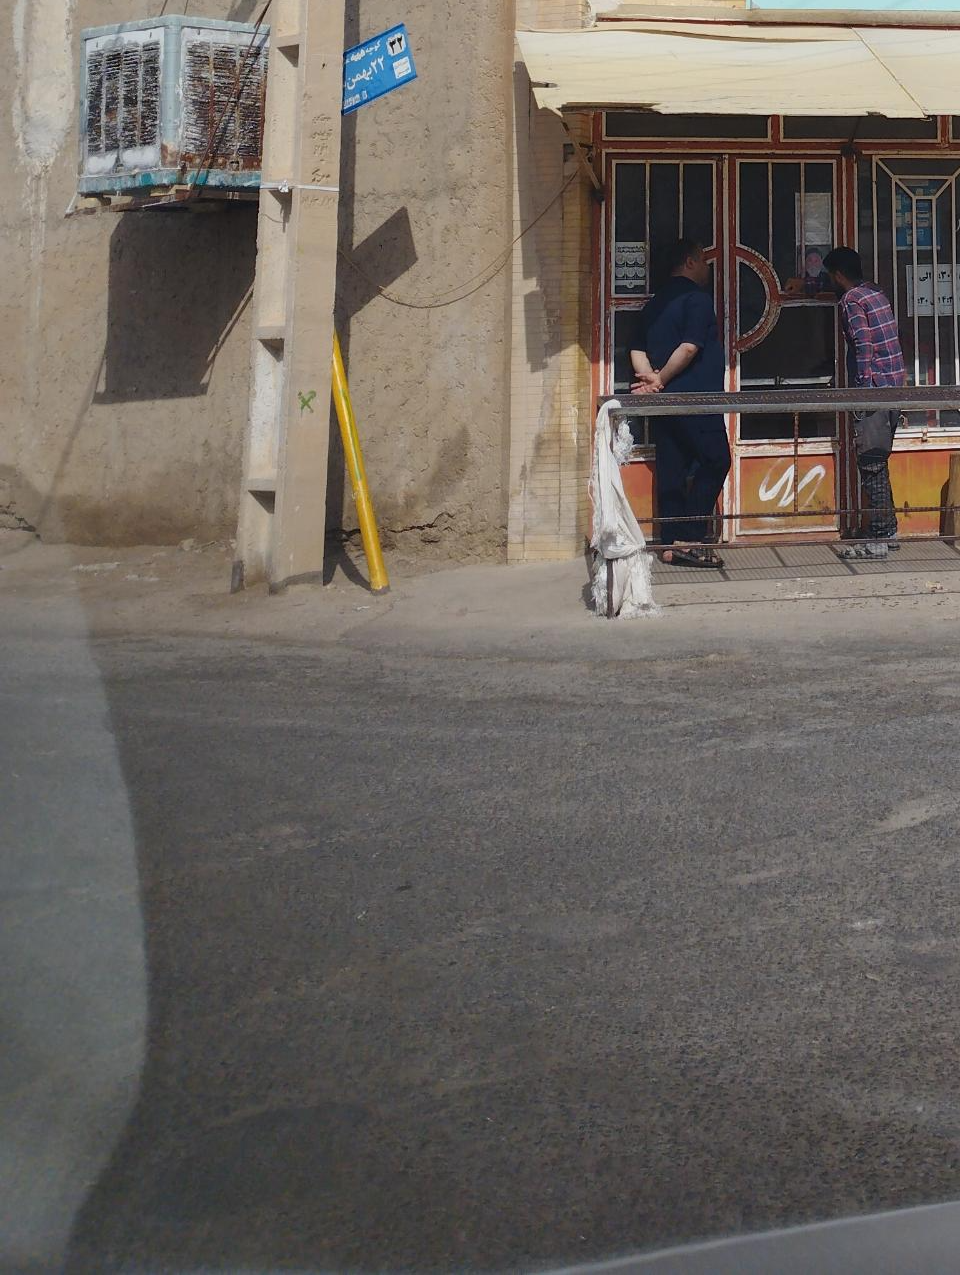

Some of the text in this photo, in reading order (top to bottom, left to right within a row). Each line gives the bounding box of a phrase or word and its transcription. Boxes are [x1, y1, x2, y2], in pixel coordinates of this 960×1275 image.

[388, 35, 403, 55] ۳۲
[370, 54, 385, 74] ۲۲
[346, 66, 373, 90] بهمن
